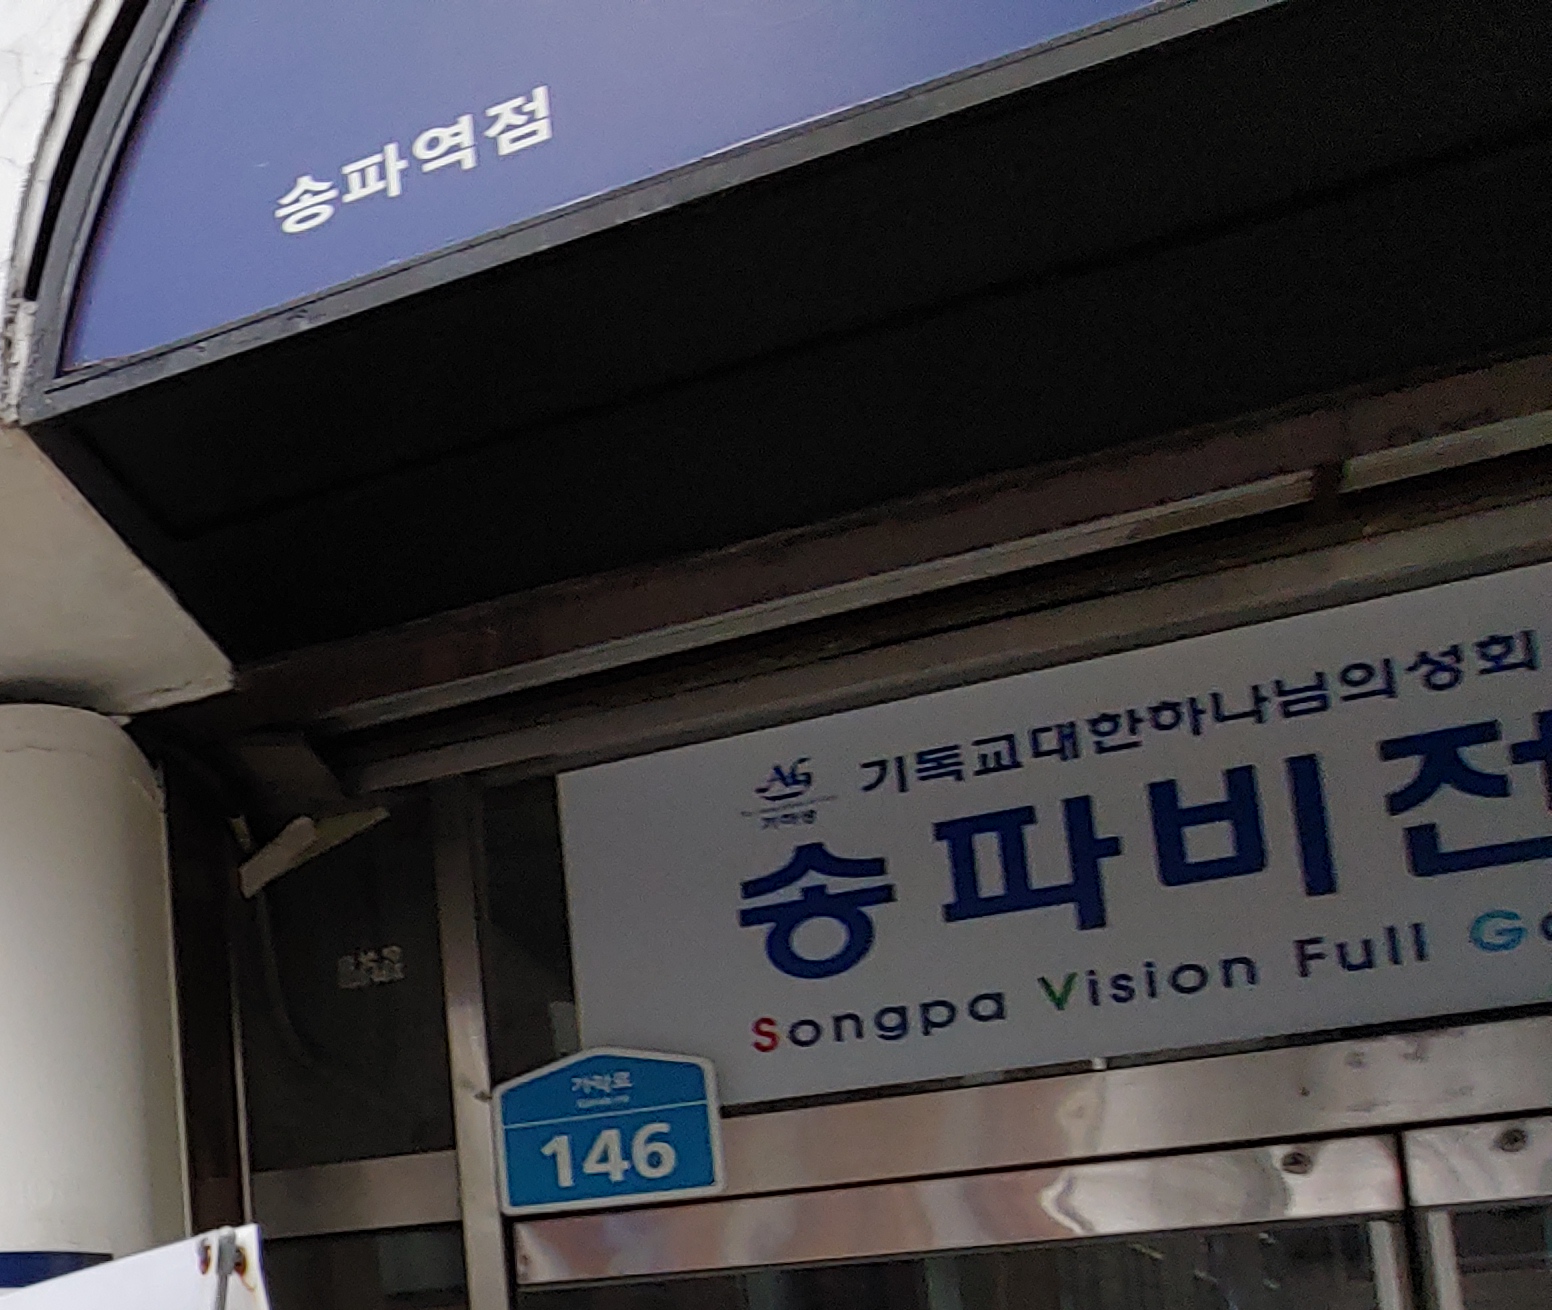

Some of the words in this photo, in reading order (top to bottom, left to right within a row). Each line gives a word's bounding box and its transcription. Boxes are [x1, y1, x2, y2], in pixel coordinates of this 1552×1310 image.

[273, 84, 554, 236] 송파역점
[859, 629, 1539, 794] 기독교대한하나님의성회
[737, 709, 1552, 980] 송파비전
[751, 991, 1007, 1053] Songpa
[1037, 956, 1259, 1012] Vision
[1292, 921, 1430, 979] Full
[540, 1121, 678, 1188] 146
